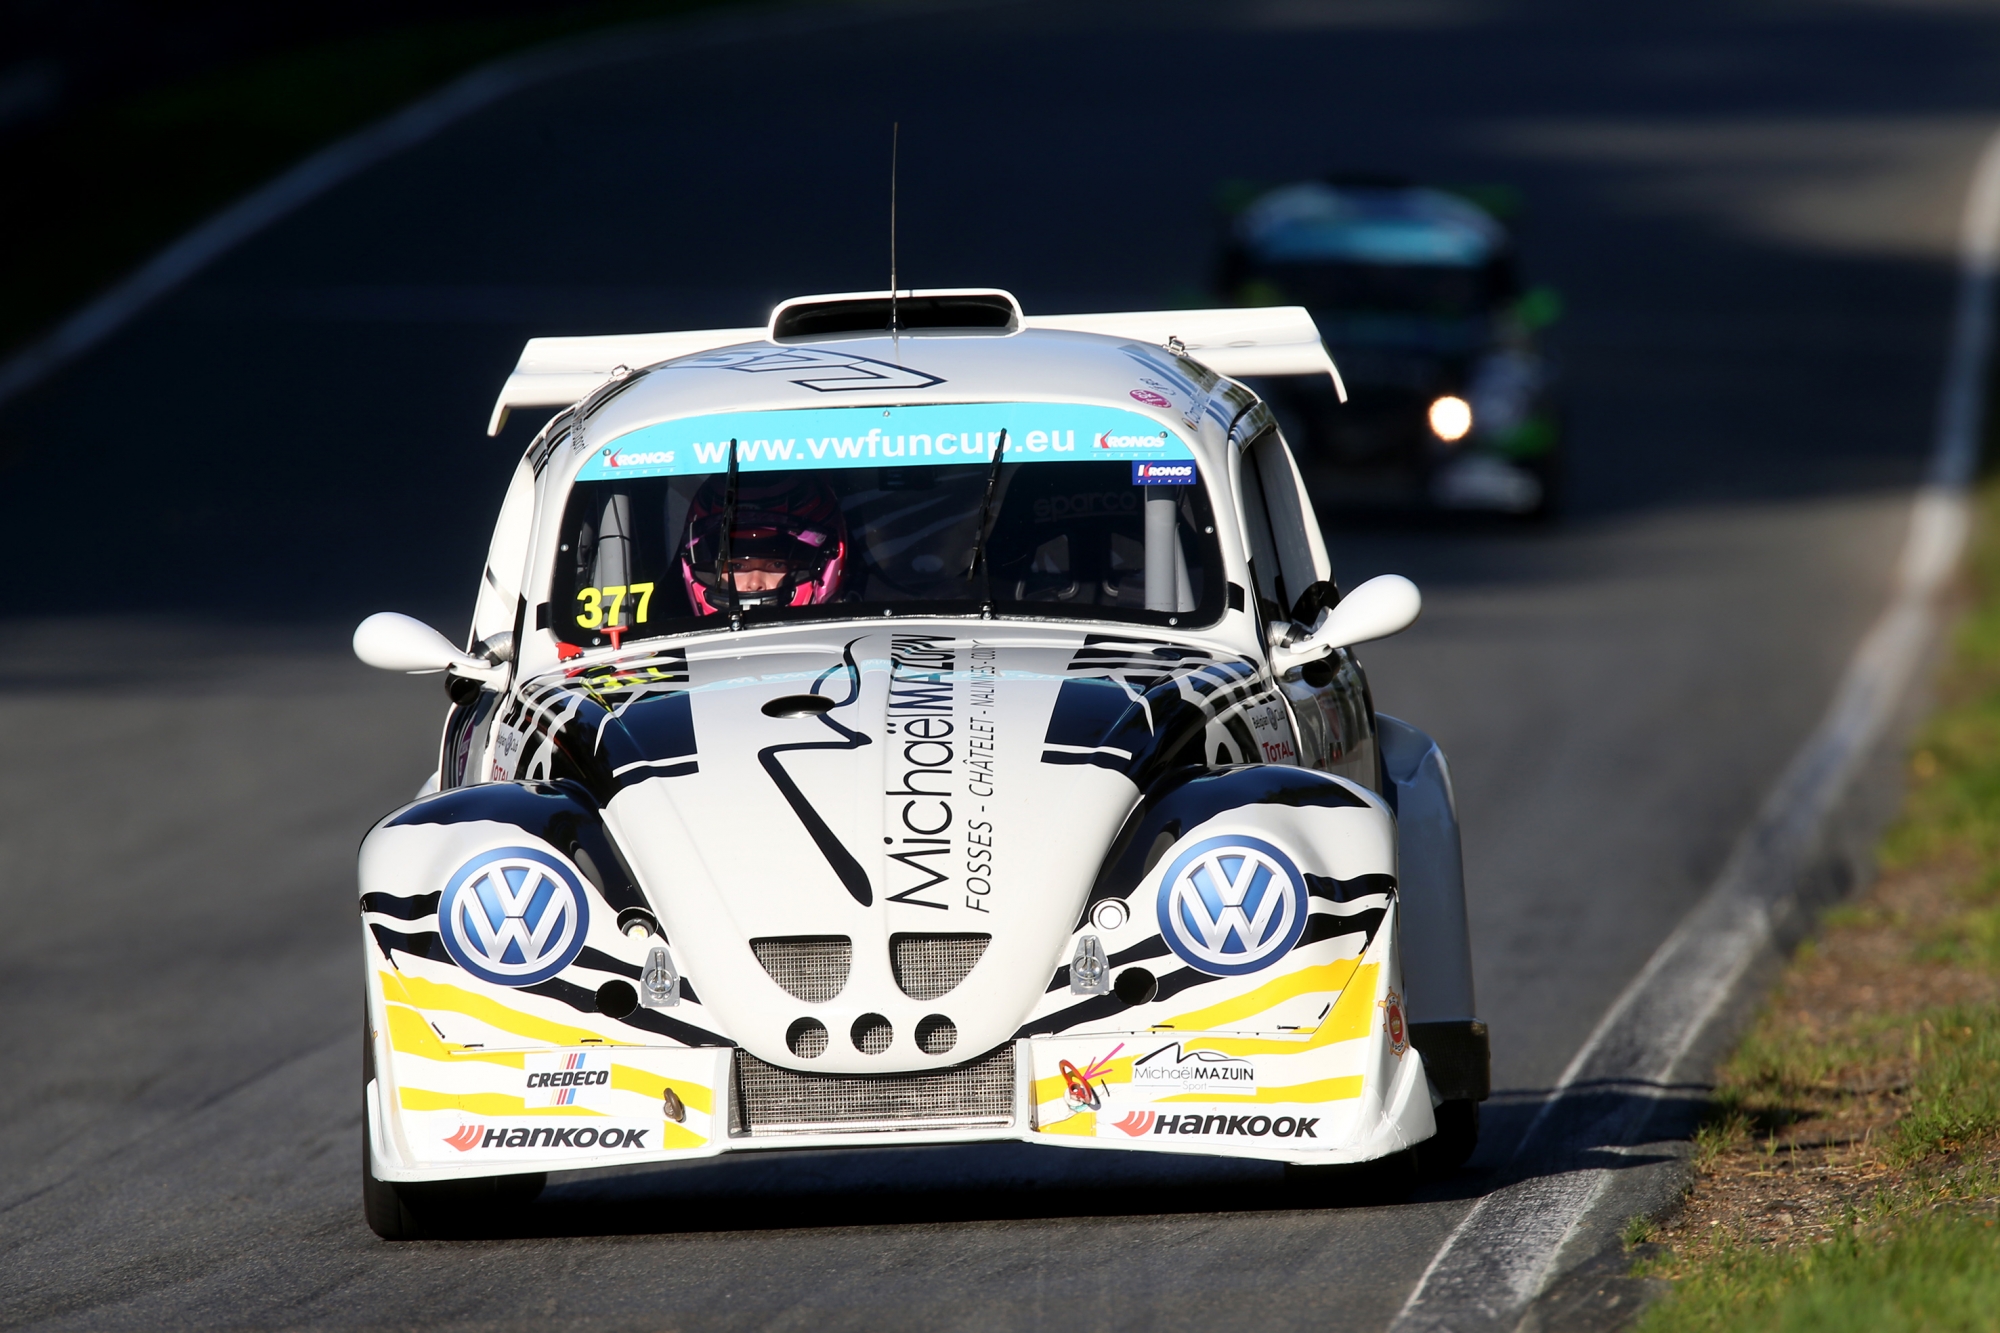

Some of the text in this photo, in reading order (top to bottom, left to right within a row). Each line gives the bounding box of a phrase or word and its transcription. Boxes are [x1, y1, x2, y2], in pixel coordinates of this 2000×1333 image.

[692, 428, 1076, 464] www.vwfuncup.eu
[1093, 429, 1165, 449] KRONOS
[602, 447, 675, 468] KRONOS
[1137, 462, 1192, 477] KRONOS
[576, 582, 654, 628] 377
[962, 716, 994, 797] CHÂTELET
[1262, 741, 1295, 763] TOTAL
[965, 819, 993, 914] FOSSES
[527, 1070, 609, 1088] CREDECO
[1182, 1081, 1207, 1092] Sport
